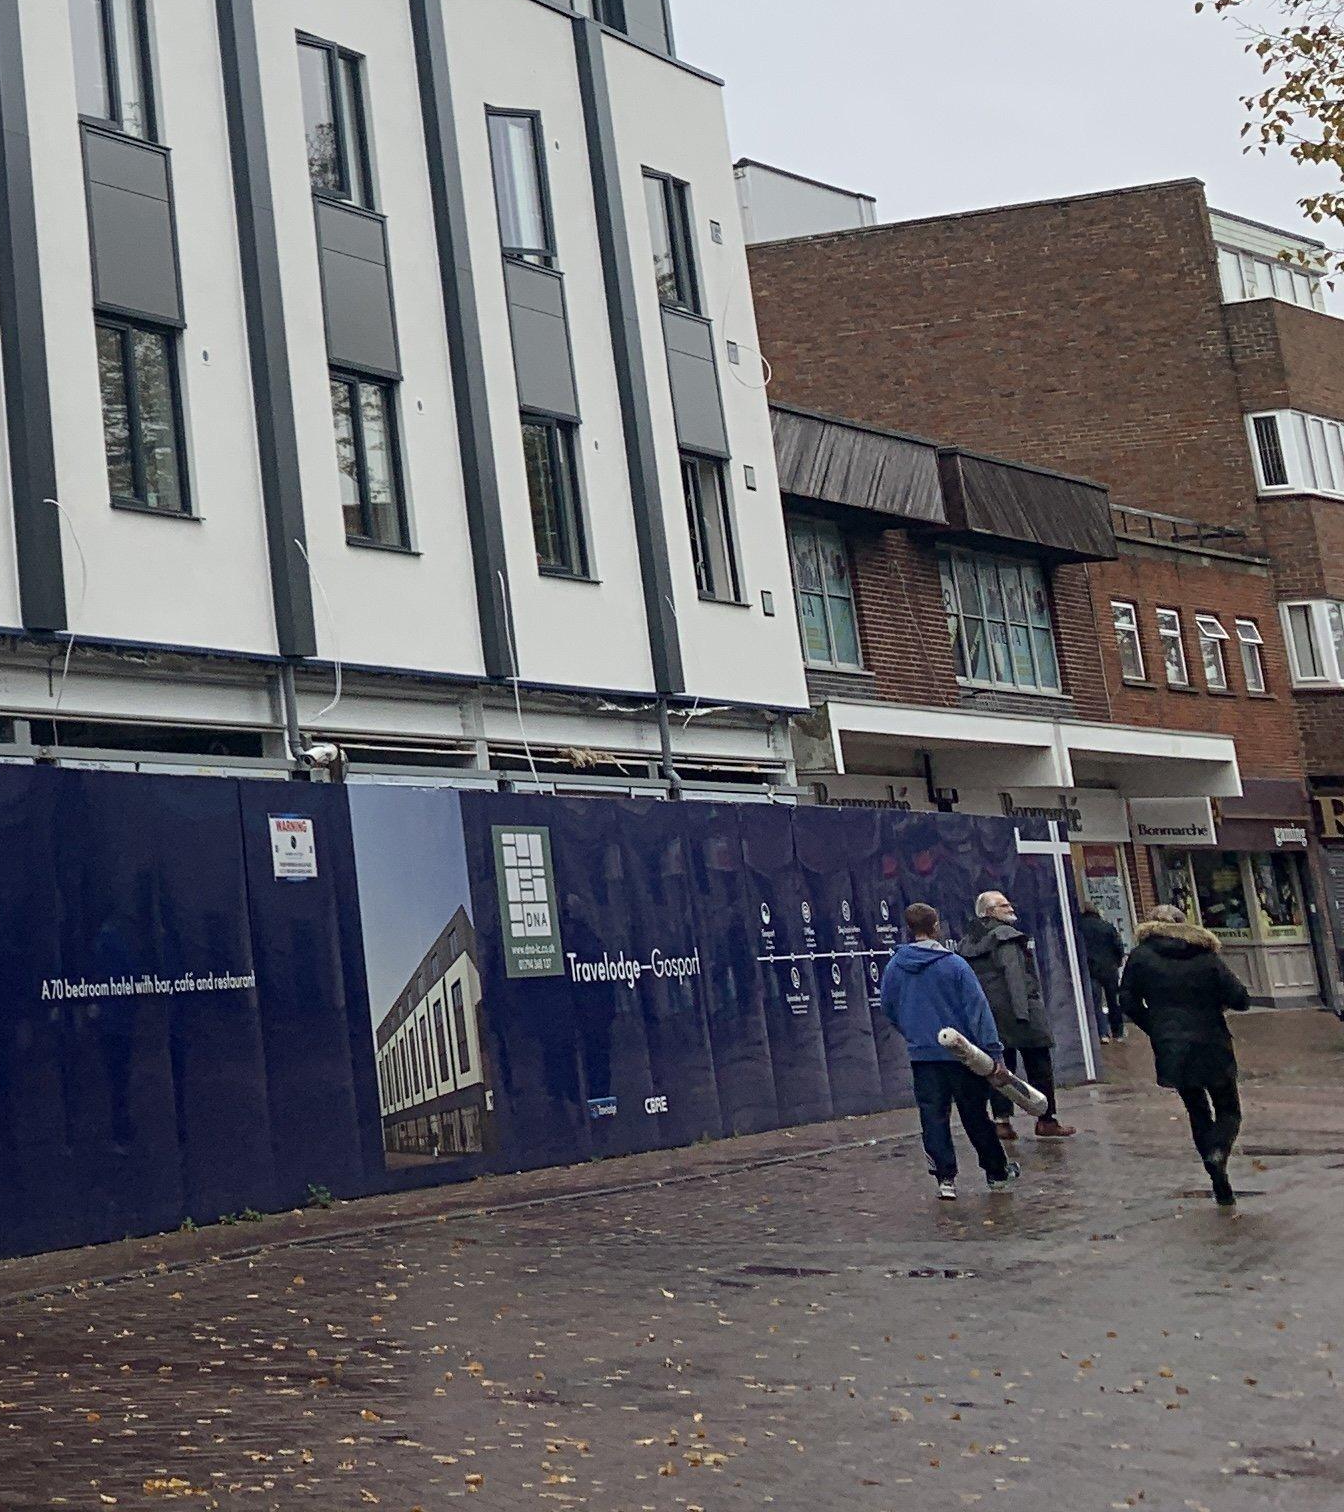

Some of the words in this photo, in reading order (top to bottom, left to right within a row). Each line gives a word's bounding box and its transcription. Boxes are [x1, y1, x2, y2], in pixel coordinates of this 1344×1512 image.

[526, 912, 548, 928] DNA
[41, 980, 51, 1000] A
[51, 979, 63, 999] 70
[64, 977, 110, 998] bedroom
[110, 975, 134, 995] hotel
[134, 974, 153, 994] with
[196, 971, 212, 990] and
[214, 969, 256, 989] restaurant
